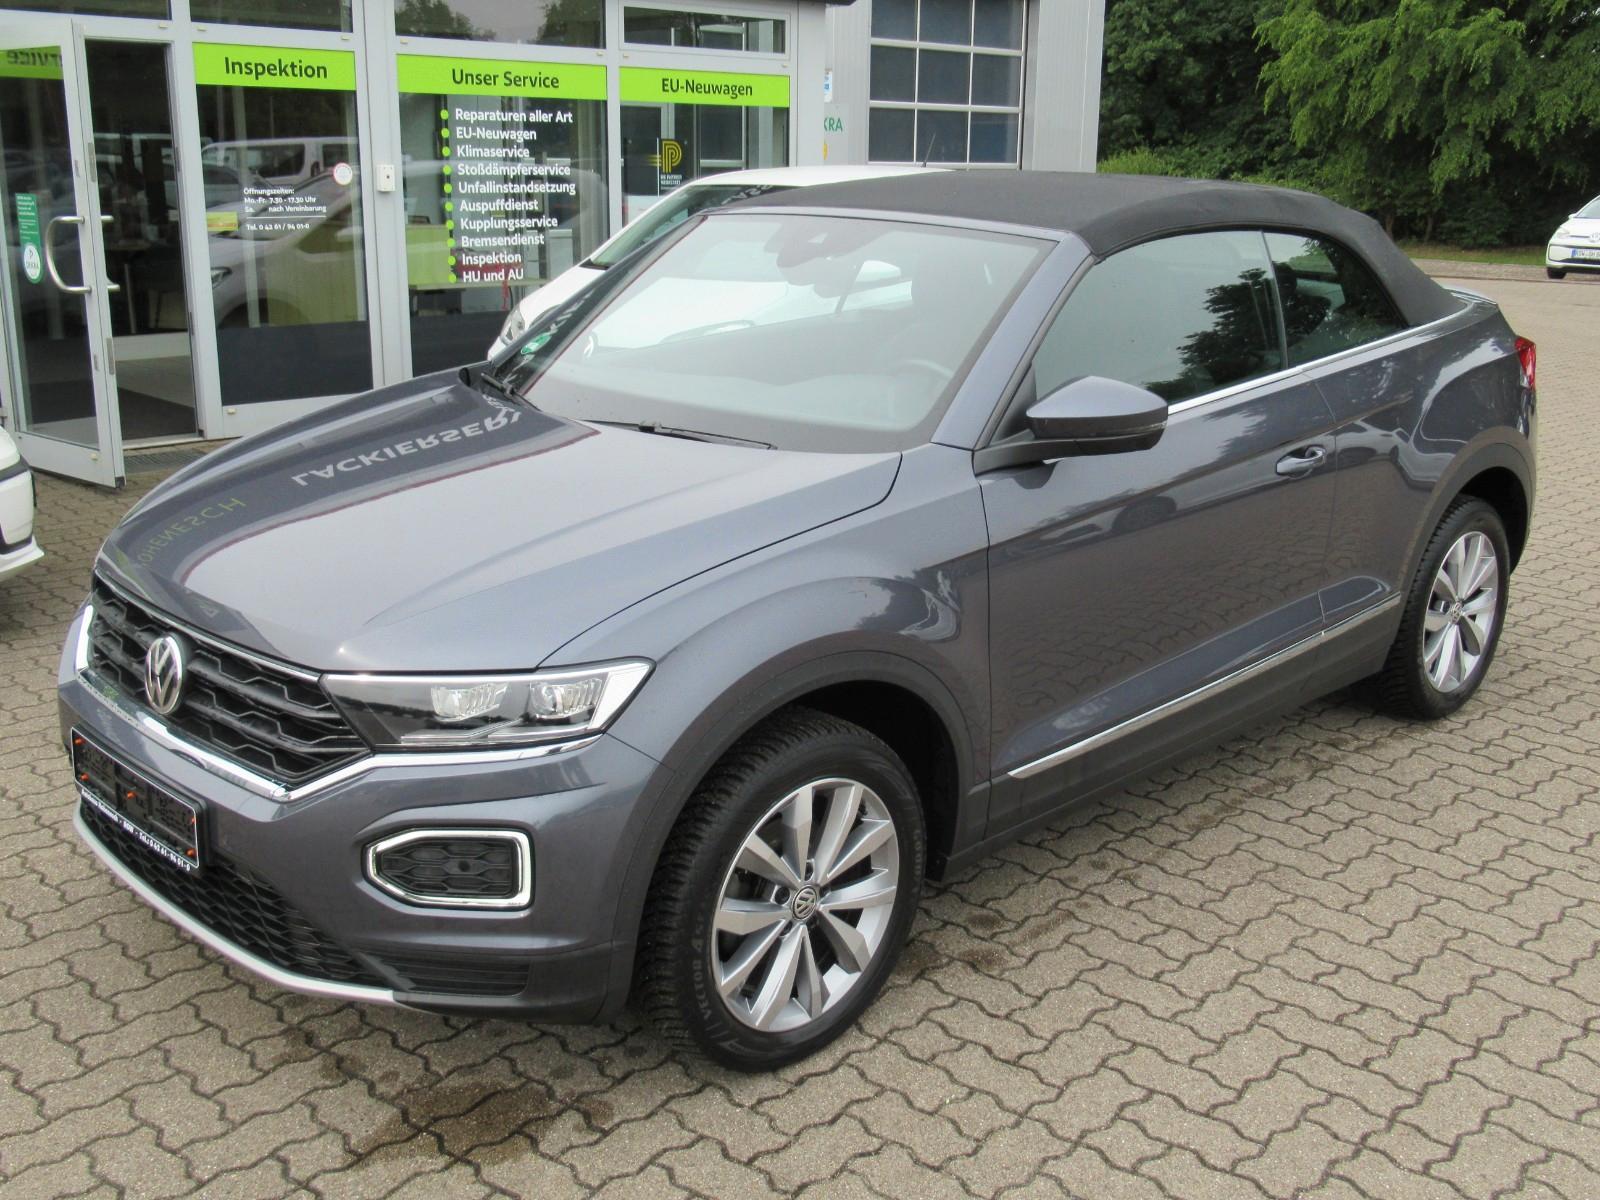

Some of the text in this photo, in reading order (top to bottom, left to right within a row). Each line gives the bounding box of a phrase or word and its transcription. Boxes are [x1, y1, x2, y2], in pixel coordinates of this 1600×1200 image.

[224, 56, 328, 80] Inspektion
[451, 67, 560, 89] Unser Service
[661, 77, 753, 99] EU-Neuwagen
[455, 108, 573, 124] Reparaturen aller Art
[456, 127, 537, 143] EU-Neuwagen
[456, 145, 530, 158] Klimaservice
[457, 163, 571, 178] Stoßdämpferservice
[458, 181, 576, 195] Unfallinstandsetzung
[285, 205, 327, 213] Vereinbarung
[460, 198, 538, 214] Auspuffdienst
[460, 215, 558, 232] Kupplungsservice
[461, 233, 545, 248] Bremsendienst
[462, 251, 522, 267] Inspektion
[463, 268, 524, 283] HU und AU
